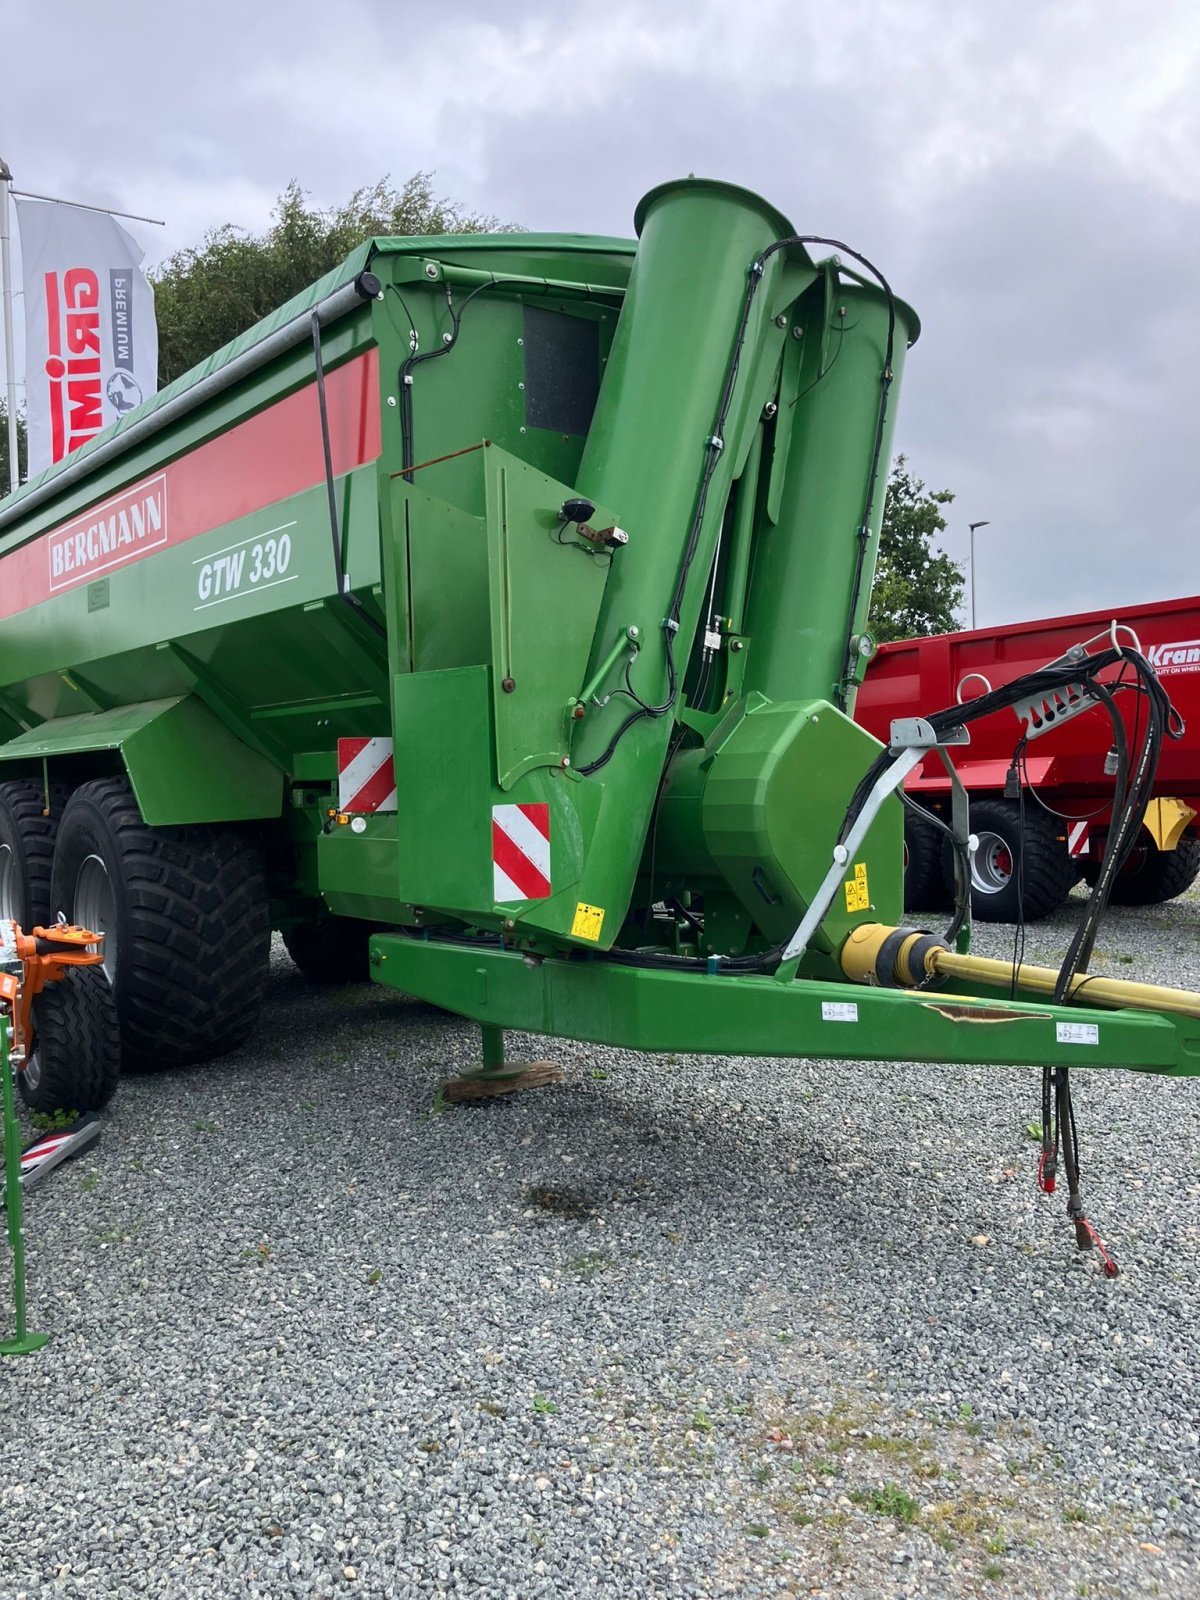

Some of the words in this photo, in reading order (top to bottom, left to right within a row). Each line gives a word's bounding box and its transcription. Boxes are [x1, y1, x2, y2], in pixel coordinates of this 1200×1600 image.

[52, 492, 162, 578] BERGMANN
[198, 550, 246, 601] GTW
[250, 534, 291, 583] 330
